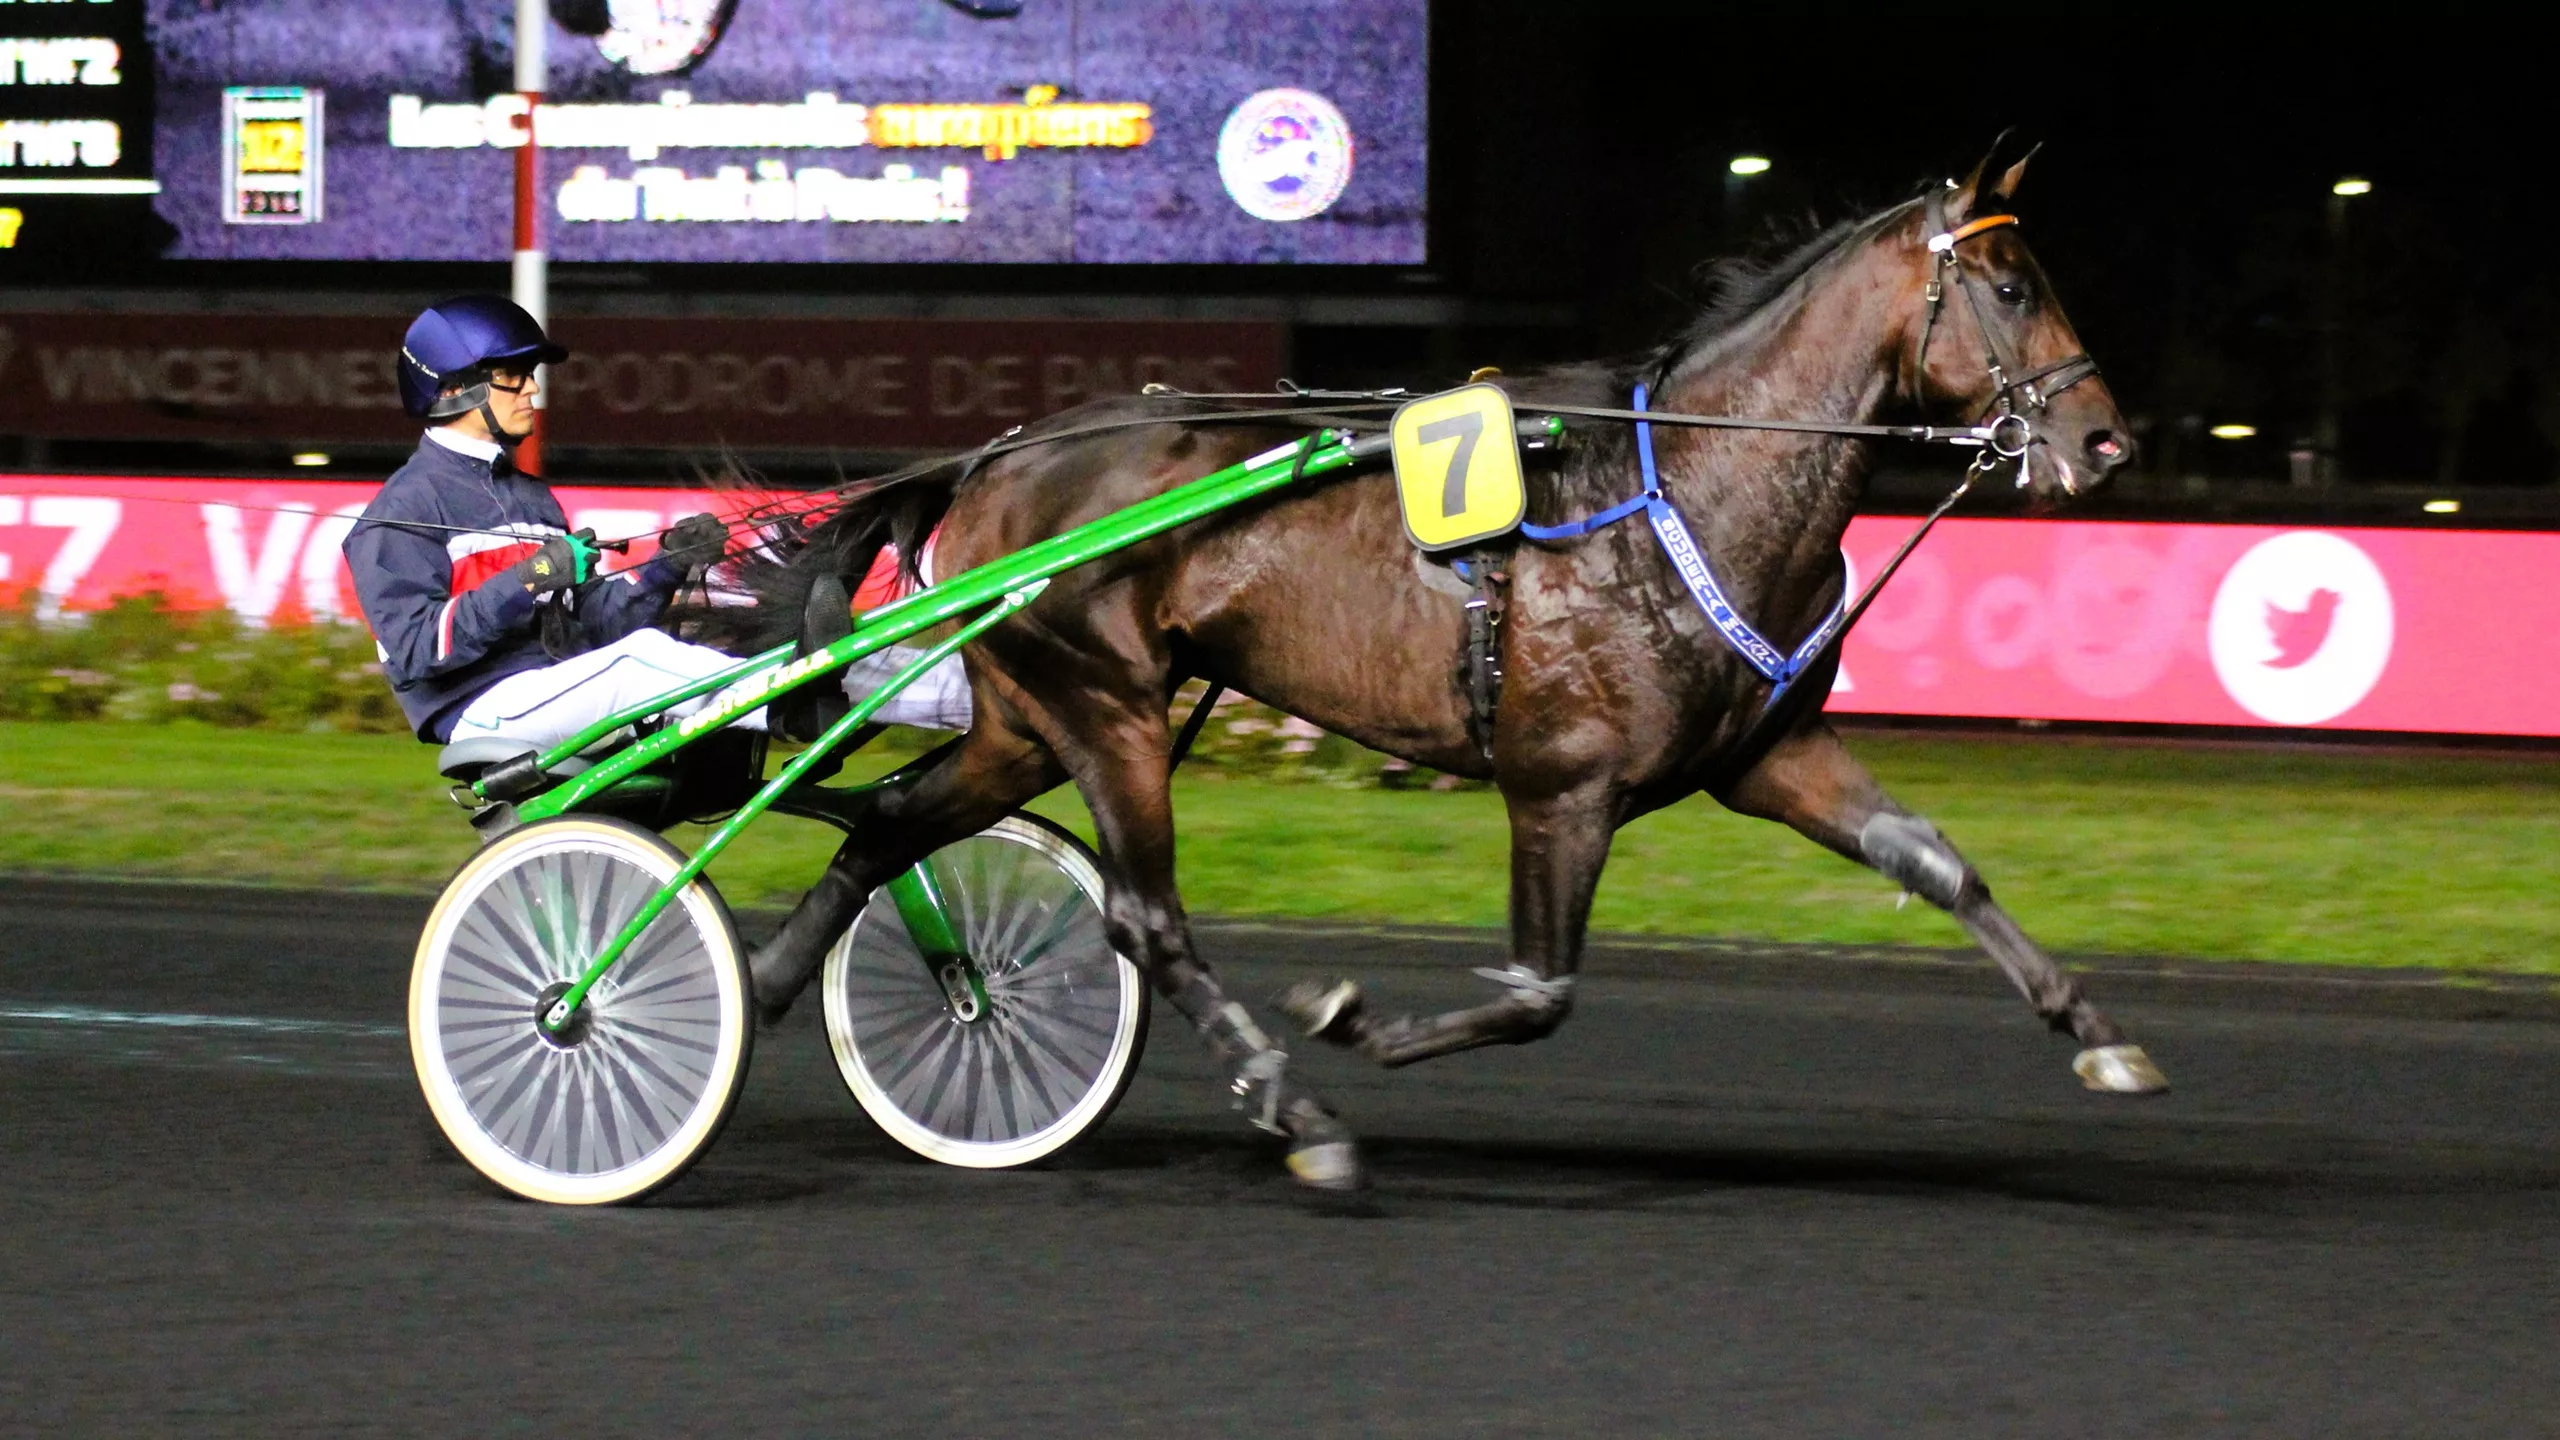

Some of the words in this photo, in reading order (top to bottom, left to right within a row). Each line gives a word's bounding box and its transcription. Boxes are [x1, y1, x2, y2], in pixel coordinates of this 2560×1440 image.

[36, 347, 406, 407] VINCENNE
[556, 352, 907, 416] PODROME
[932, 356, 1028, 416] DE
[1417, 411, 1483, 518] 7
[1660, 518, 1723, 612] SCUDERIA
